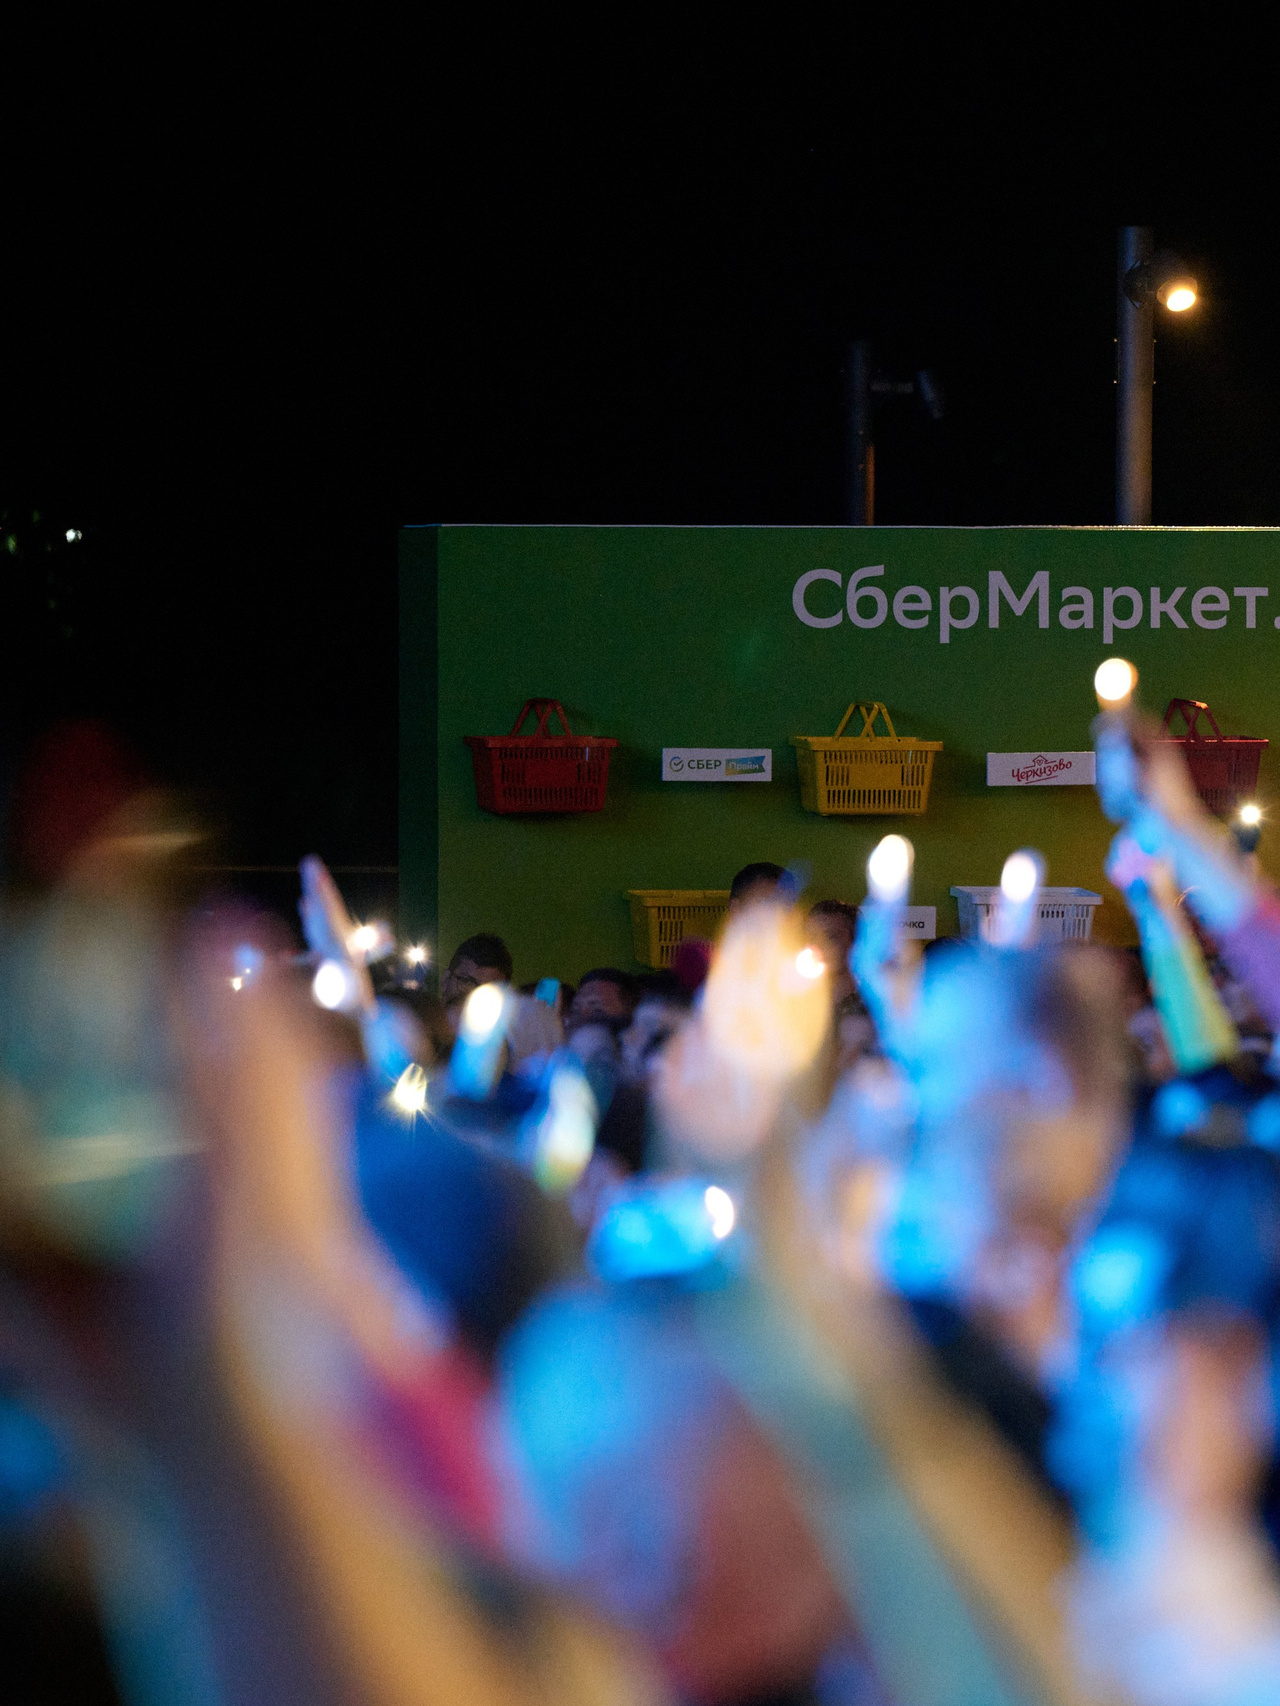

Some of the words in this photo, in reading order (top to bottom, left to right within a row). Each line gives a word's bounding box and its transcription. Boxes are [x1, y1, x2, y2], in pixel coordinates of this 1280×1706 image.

[687, 759, 722, 770] СБЕР
[729, 761, 760, 771] Прайм
[1011, 758, 1073, 782] Черкизово
